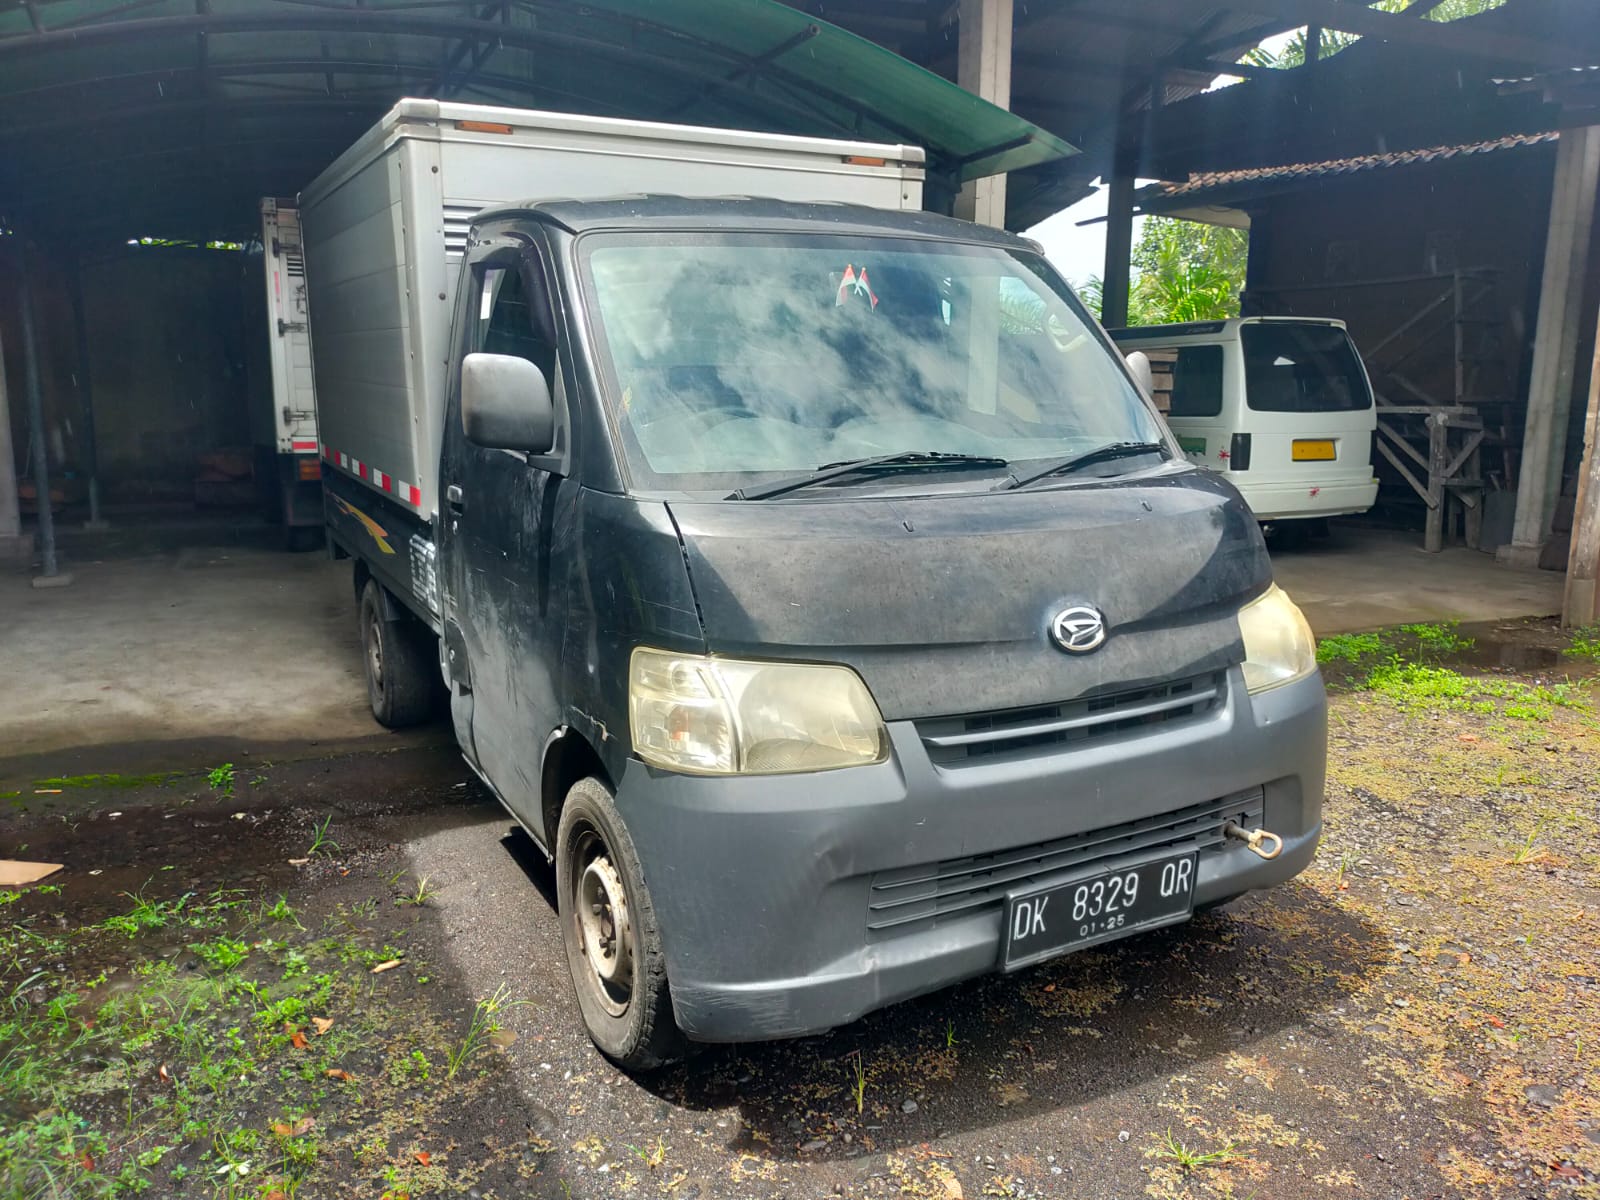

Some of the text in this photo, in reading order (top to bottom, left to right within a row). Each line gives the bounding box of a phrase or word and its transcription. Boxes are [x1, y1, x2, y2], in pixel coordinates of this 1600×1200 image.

[1013, 858, 1192, 940] DK 8329 QR
